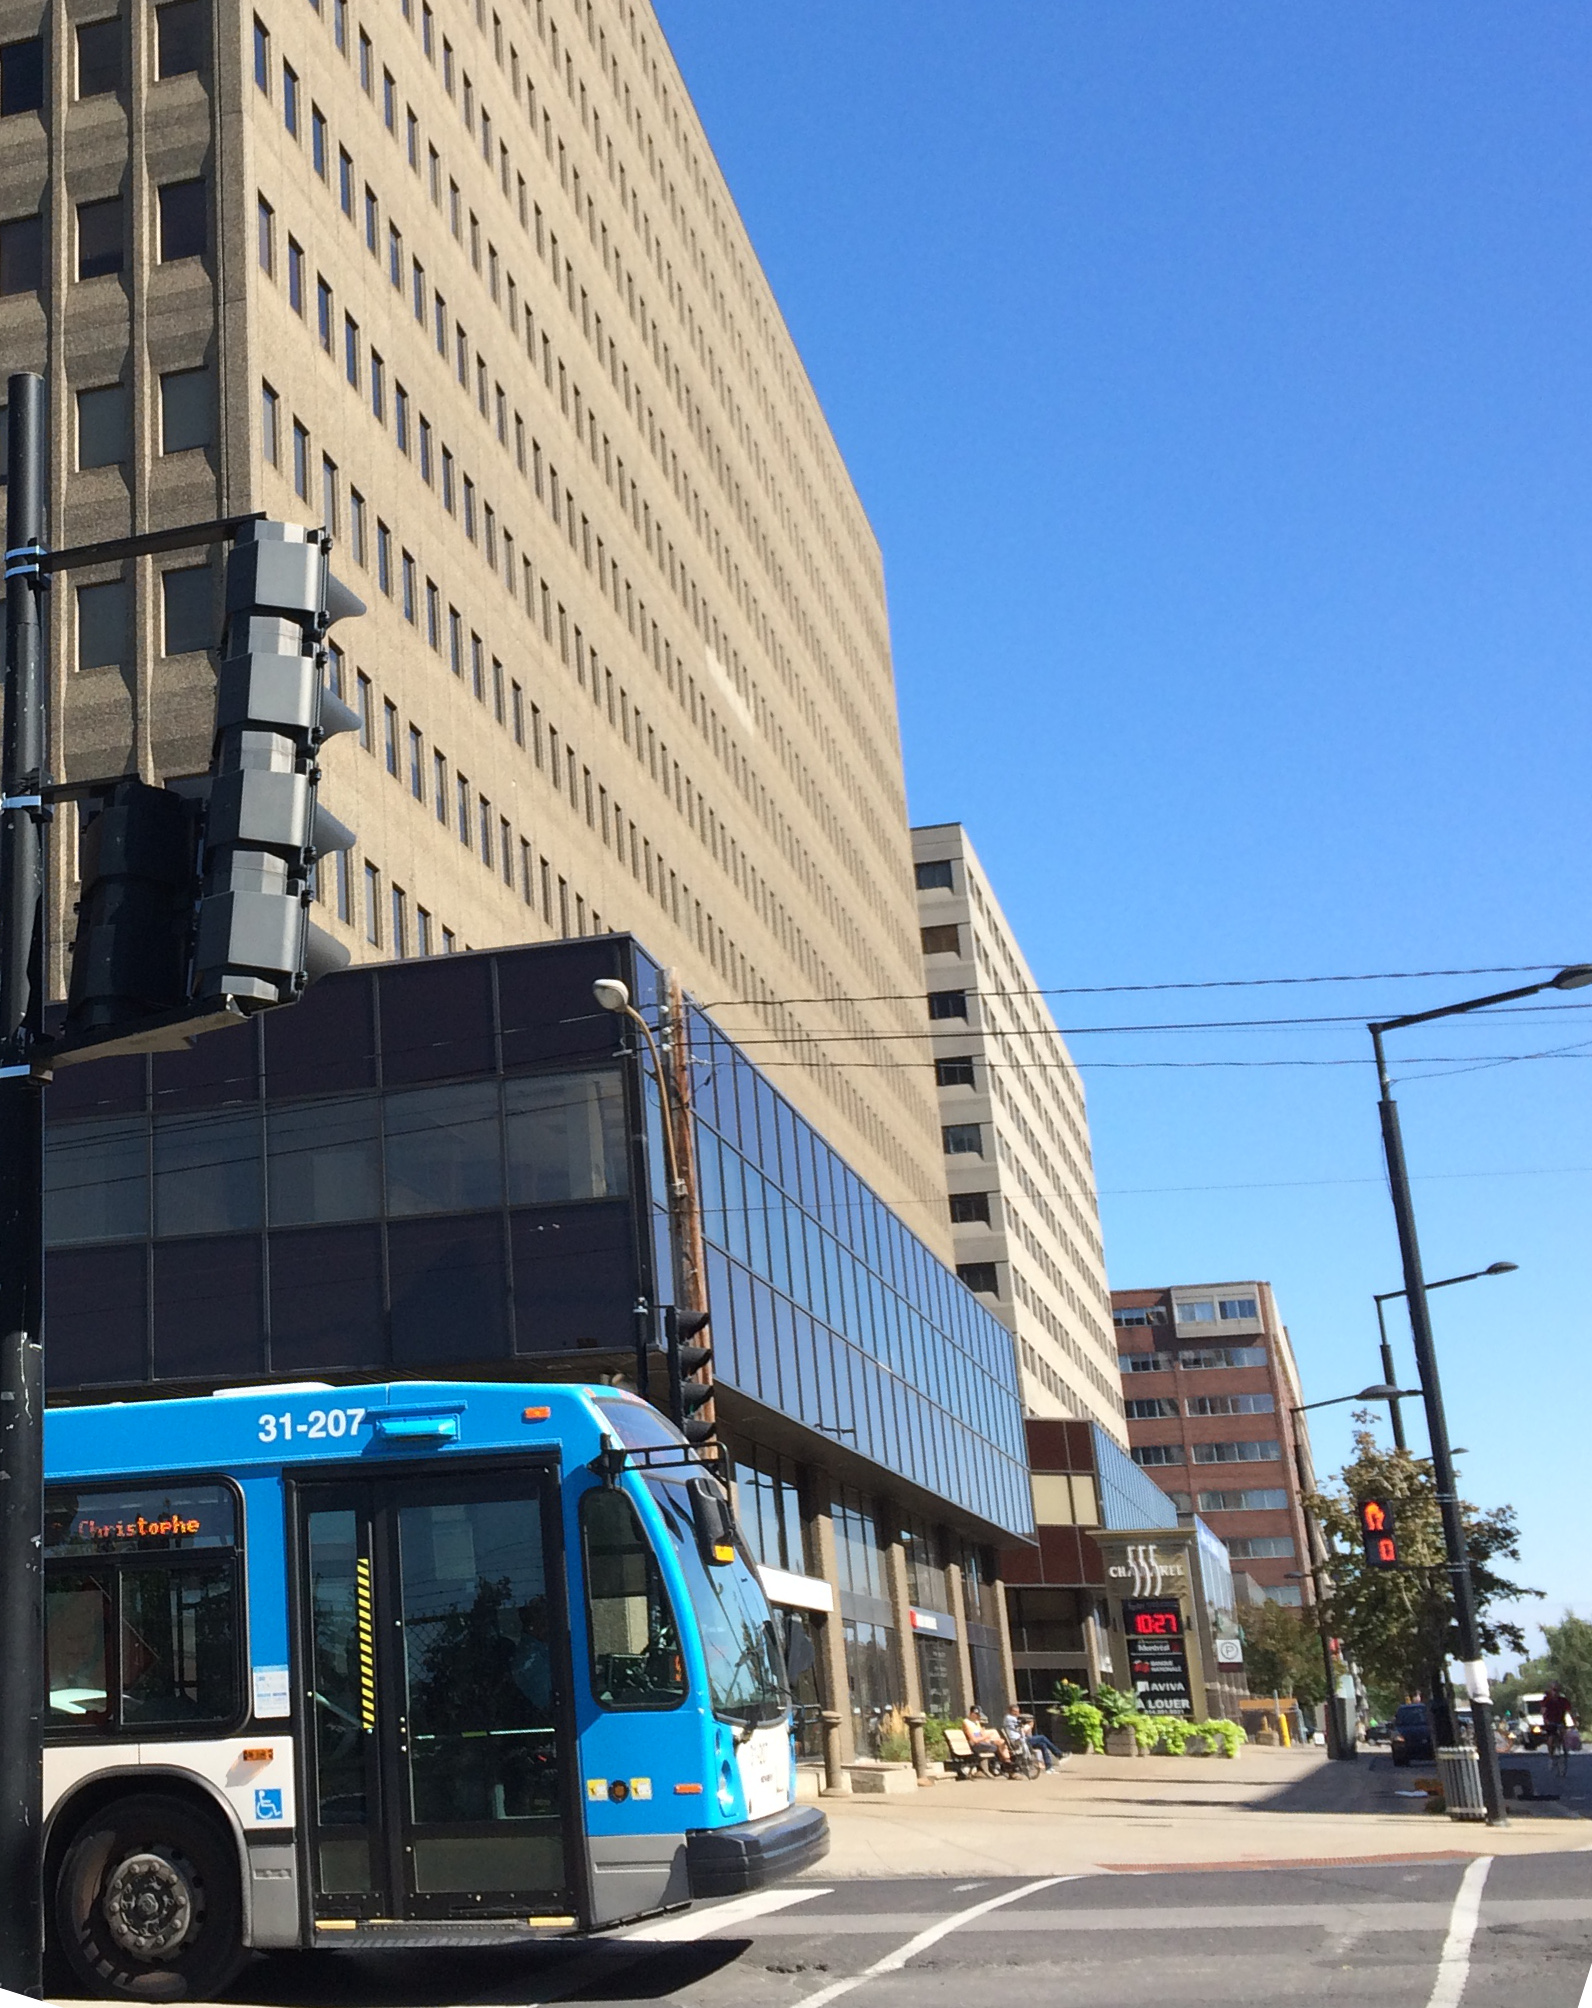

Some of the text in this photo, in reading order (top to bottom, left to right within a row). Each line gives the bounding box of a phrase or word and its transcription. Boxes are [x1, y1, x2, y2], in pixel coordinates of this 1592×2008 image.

[258, 1408, 366, 1443] 31-207
[78, 1514, 201, 1538] Christophe
[1150, 1682, 1185, 1692] AVIVA
[1148, 1698, 1190, 1709] LOUER
